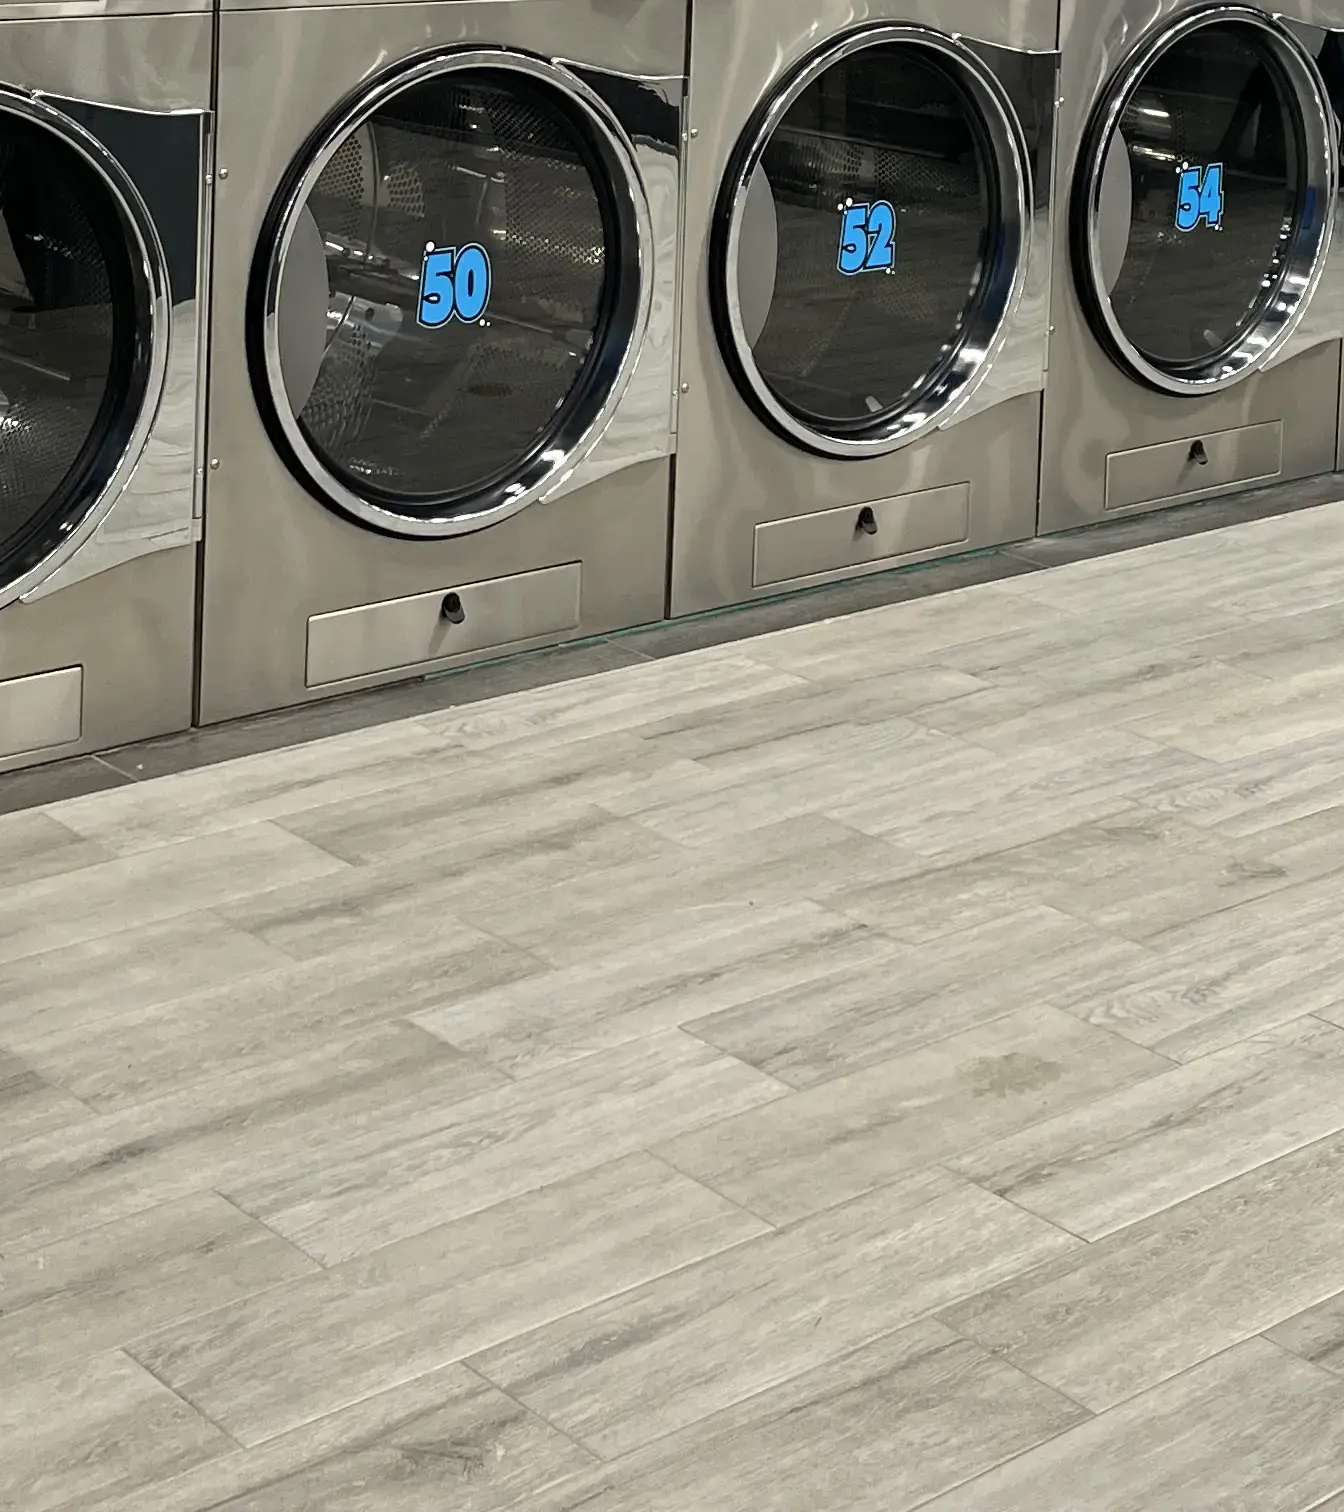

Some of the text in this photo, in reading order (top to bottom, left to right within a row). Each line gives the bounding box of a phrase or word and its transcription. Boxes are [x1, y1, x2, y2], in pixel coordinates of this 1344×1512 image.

[1175, 164, 1224, 231] 54
[837, 201, 896, 274] 52
[417, 244, 491, 328] 50
